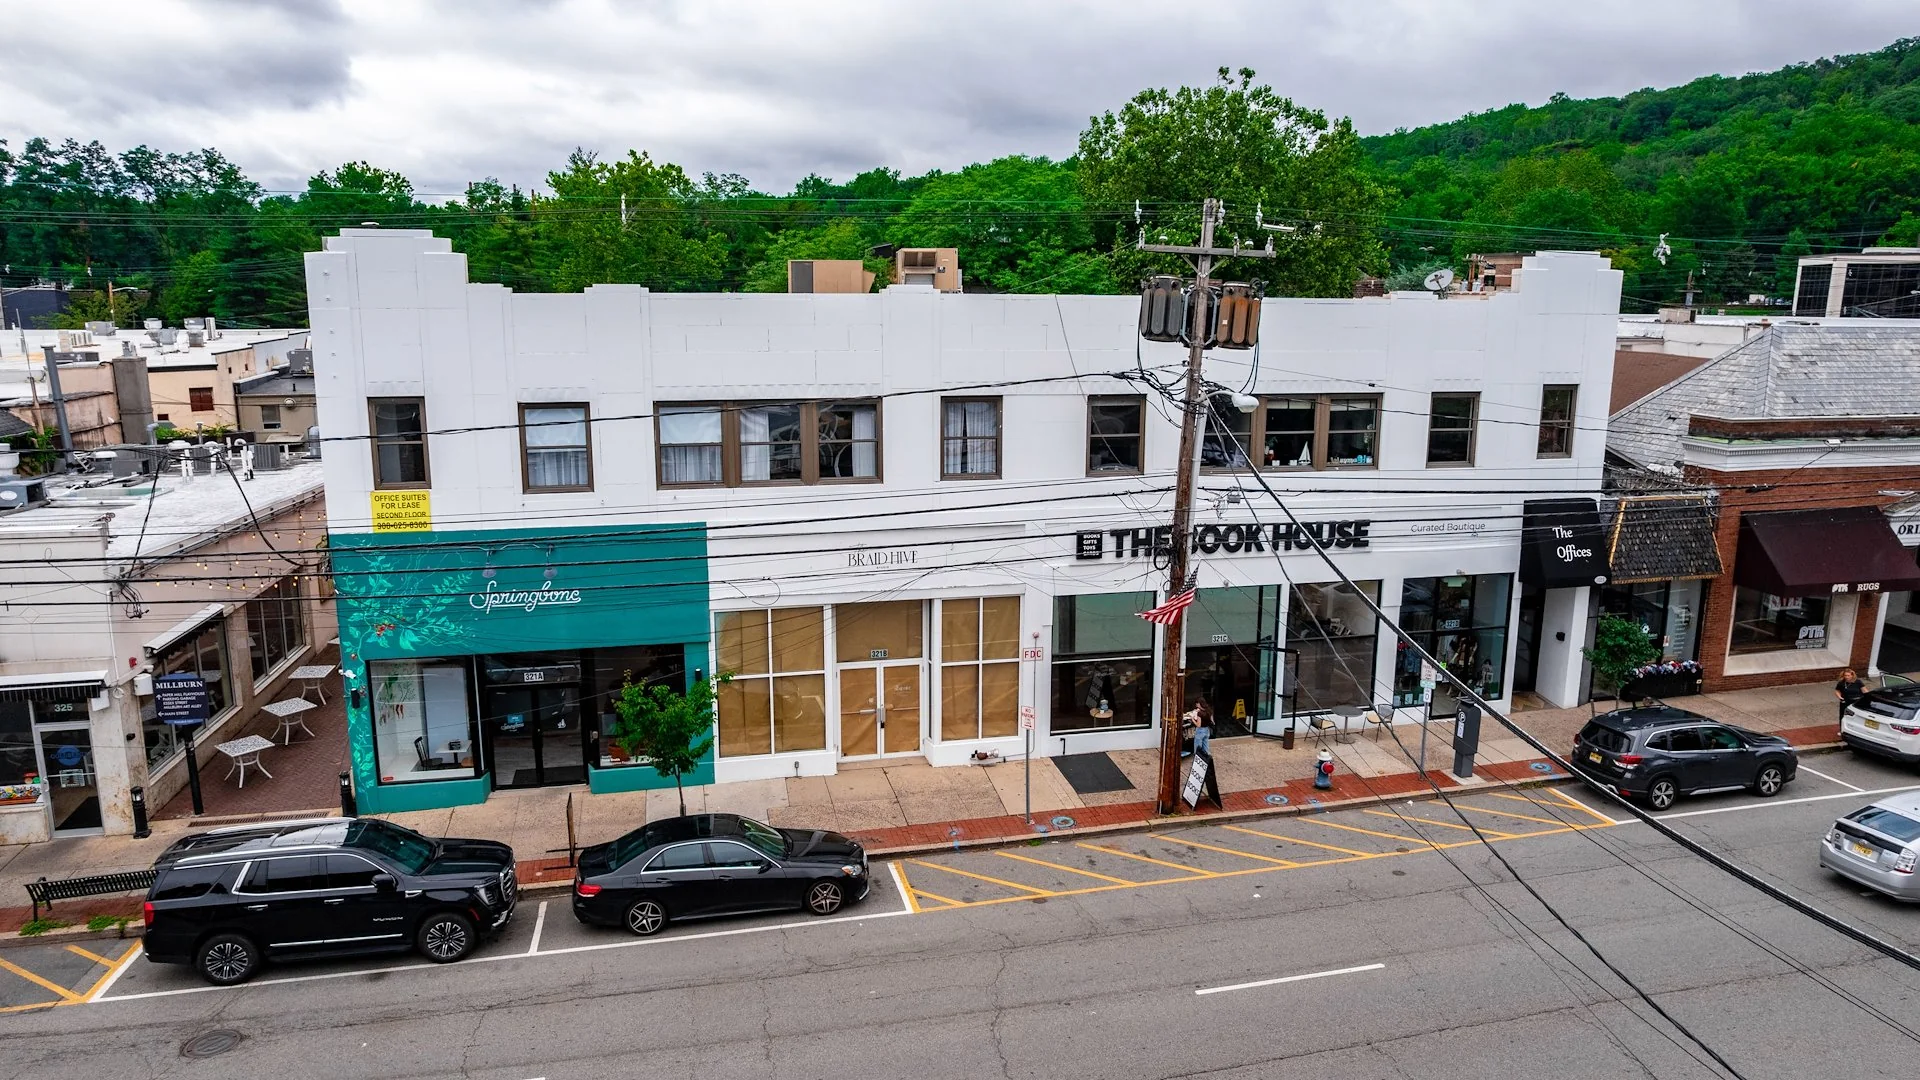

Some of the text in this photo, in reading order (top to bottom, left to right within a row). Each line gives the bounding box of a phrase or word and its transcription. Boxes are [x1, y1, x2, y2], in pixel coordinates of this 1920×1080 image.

[1411, 522, 1486, 532] Curated Boutique
[1552, 525, 1573, 538] The
[1110, 526, 1172, 557] THE
[1272, 519, 1370, 550] HOUSE
[1557, 544, 1592, 562] Offices
[848, 551, 918, 566] BRAID HIVE
[1856, 582, 1880, 591] RUGS
[469, 580, 582, 614] Springbone
[872, 650, 888, 658] 321B
[525, 672, 543, 680] 321A
[155, 681, 203, 689] MILLBURN
[55, 704, 73, 712] 325
